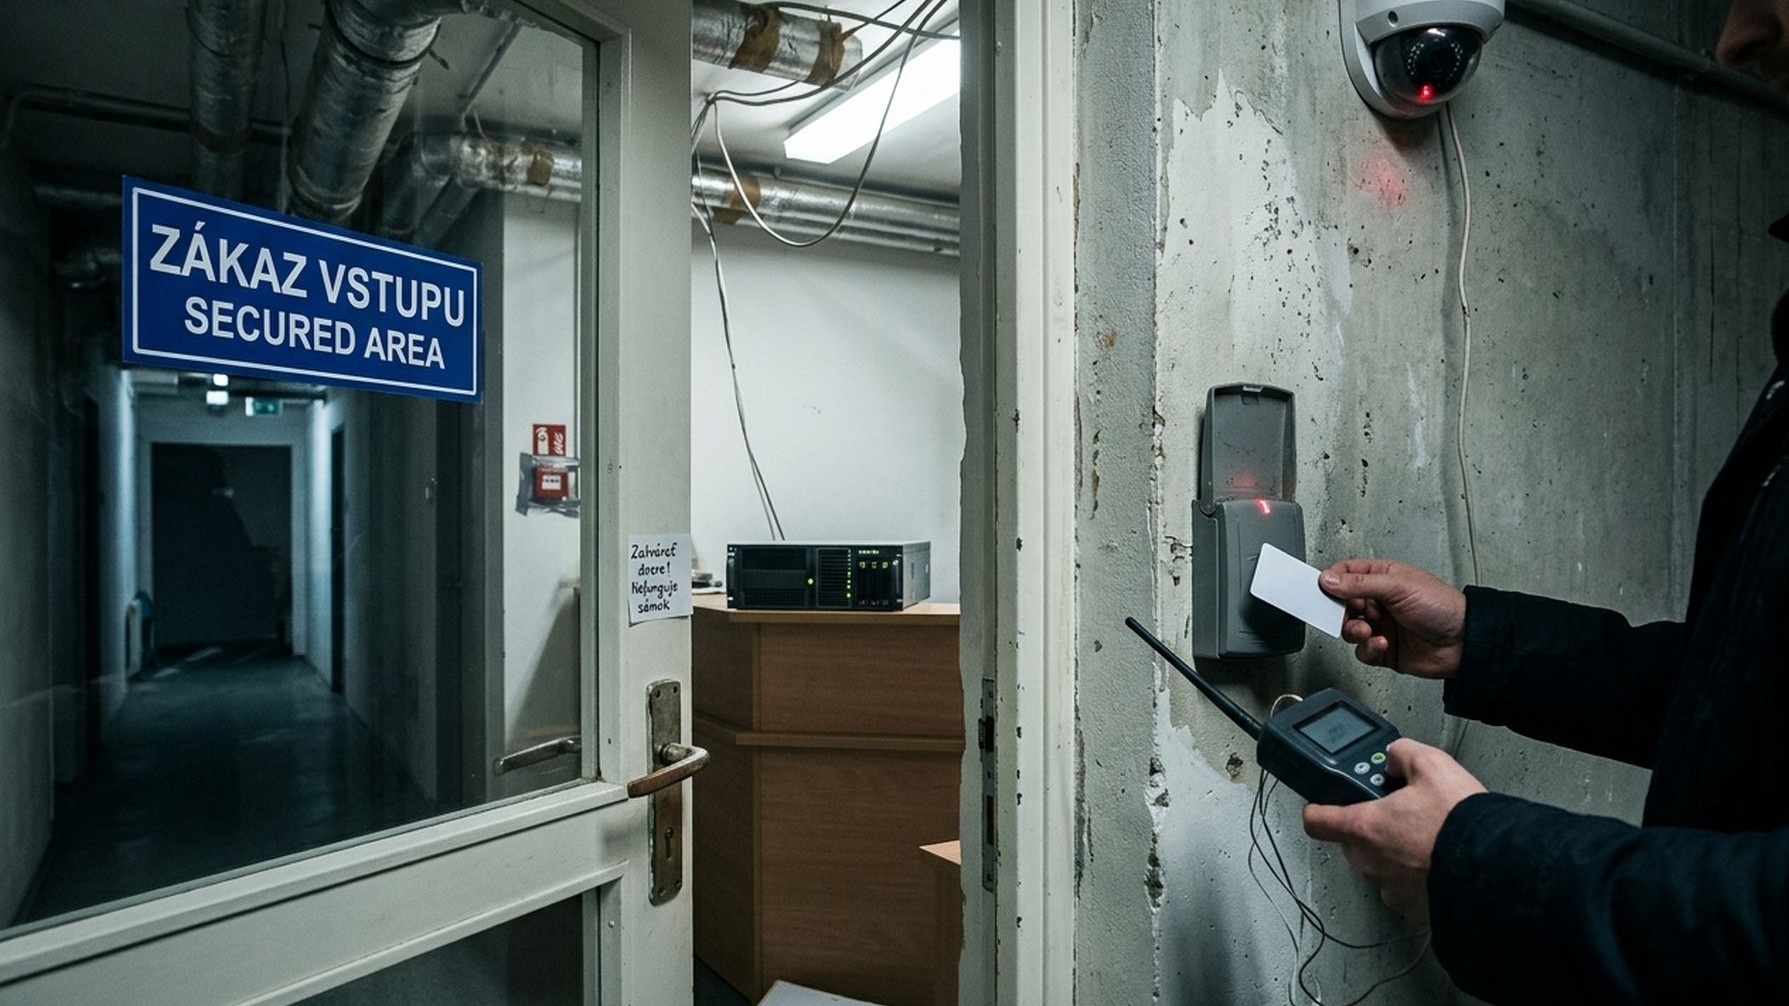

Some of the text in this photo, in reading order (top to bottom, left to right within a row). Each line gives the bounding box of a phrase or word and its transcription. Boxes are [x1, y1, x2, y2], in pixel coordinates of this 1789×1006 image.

[150, 221, 466, 327] ZÁKAZ VSTUPU
[184, 296, 445, 370] SECURED AREA
